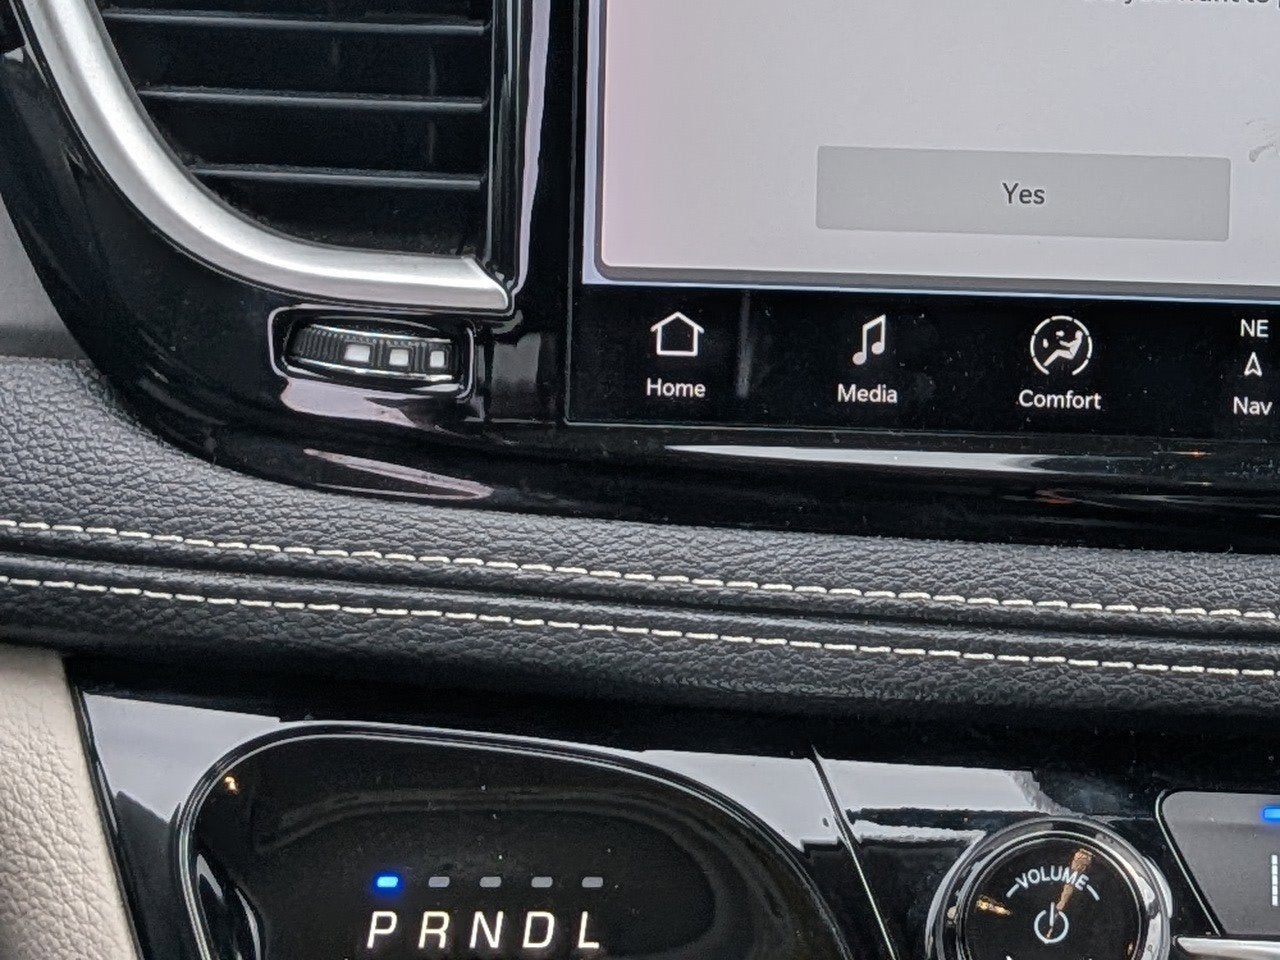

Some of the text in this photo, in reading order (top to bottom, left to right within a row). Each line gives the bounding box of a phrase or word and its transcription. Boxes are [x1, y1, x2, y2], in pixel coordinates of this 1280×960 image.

[1002, 182, 1046, 206] Yes
[1239, 319, 1270, 338] NE
[646, 377, 706, 399] Home
[837, 382, 899, 406] Media
[1018, 388, 1102, 410] Comfort
[1232, 397, 1272, 417] Nav
[1015, 864, 1090, 892] VOLUME
